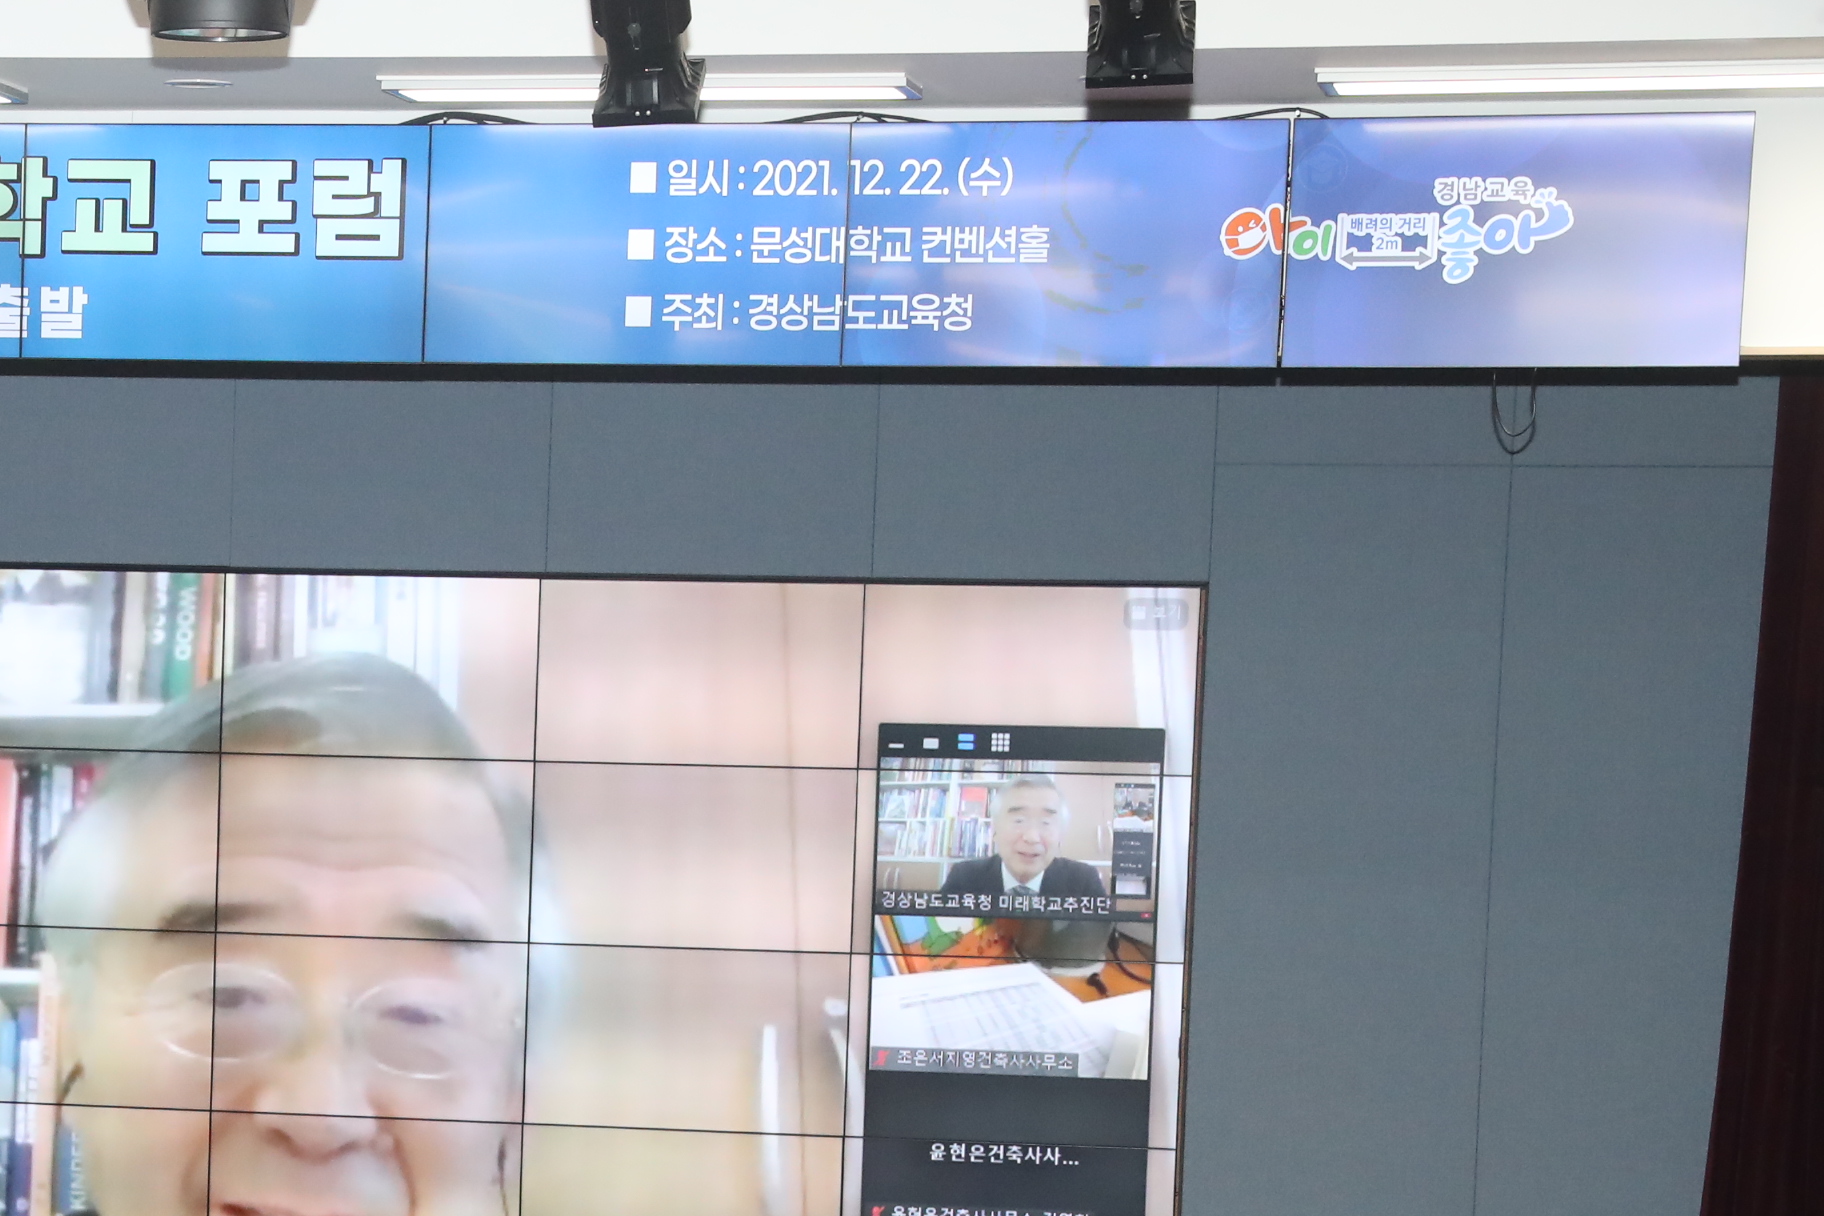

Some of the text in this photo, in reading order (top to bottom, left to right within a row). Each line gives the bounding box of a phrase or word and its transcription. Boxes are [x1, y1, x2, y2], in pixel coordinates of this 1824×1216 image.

[667, 159, 730, 197] 일시
[957, 156, 1014, 197] (수)
[1435, 178, 1533, 204] 경남교육
[201, 156, 407, 261] 포럼
[1350, 216, 1426, 233] 배려의 거리
[663, 225, 727, 263] 장소
[750, 224, 912, 264] 문성대학교
[921, 225, 1051, 264] 컨벤션홀
[1375, 236, 1399, 251] 2m
[661, 293, 724, 331] 주최
[748, 293, 973, 332] 경상남도교육청
[881, 890, 1113, 915] 경상남도교육청 미래학교추진단
